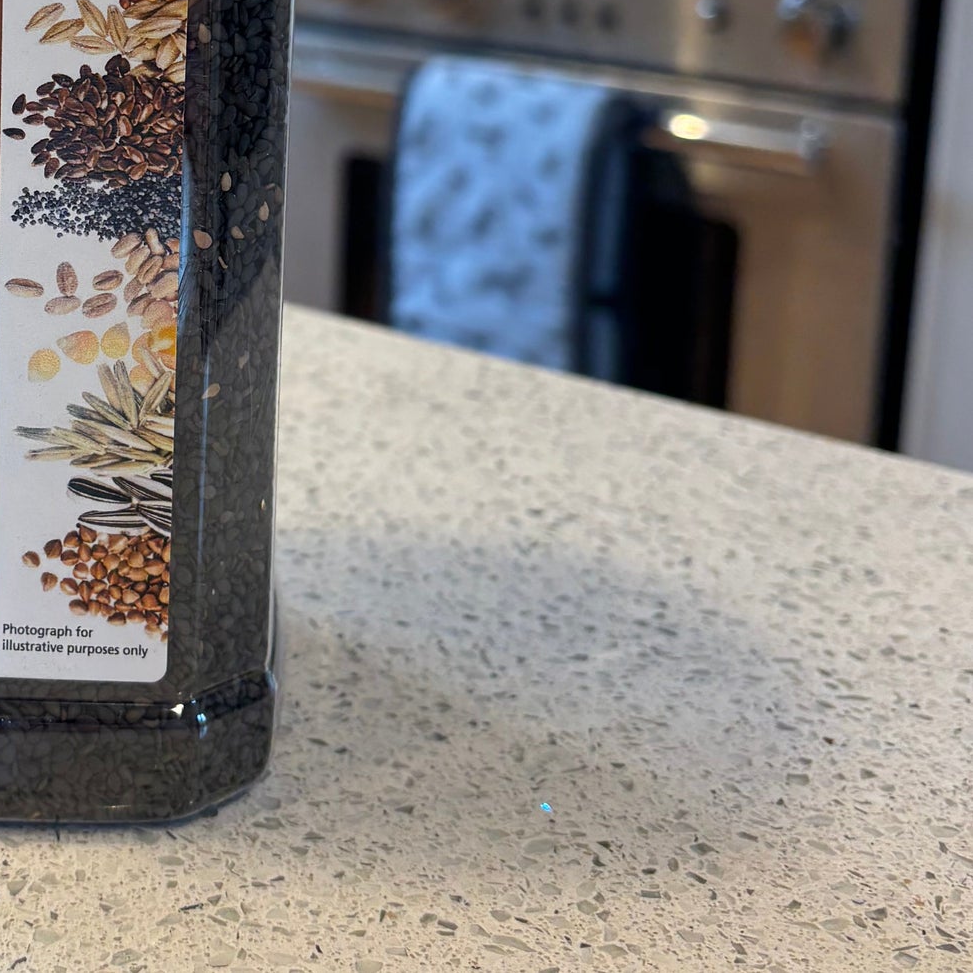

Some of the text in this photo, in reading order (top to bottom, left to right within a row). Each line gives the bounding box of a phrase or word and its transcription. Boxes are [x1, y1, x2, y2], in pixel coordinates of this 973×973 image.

[2, 623, 94, 639] Photograph for
[2, 639, 149, 658] illustrative purposes only
